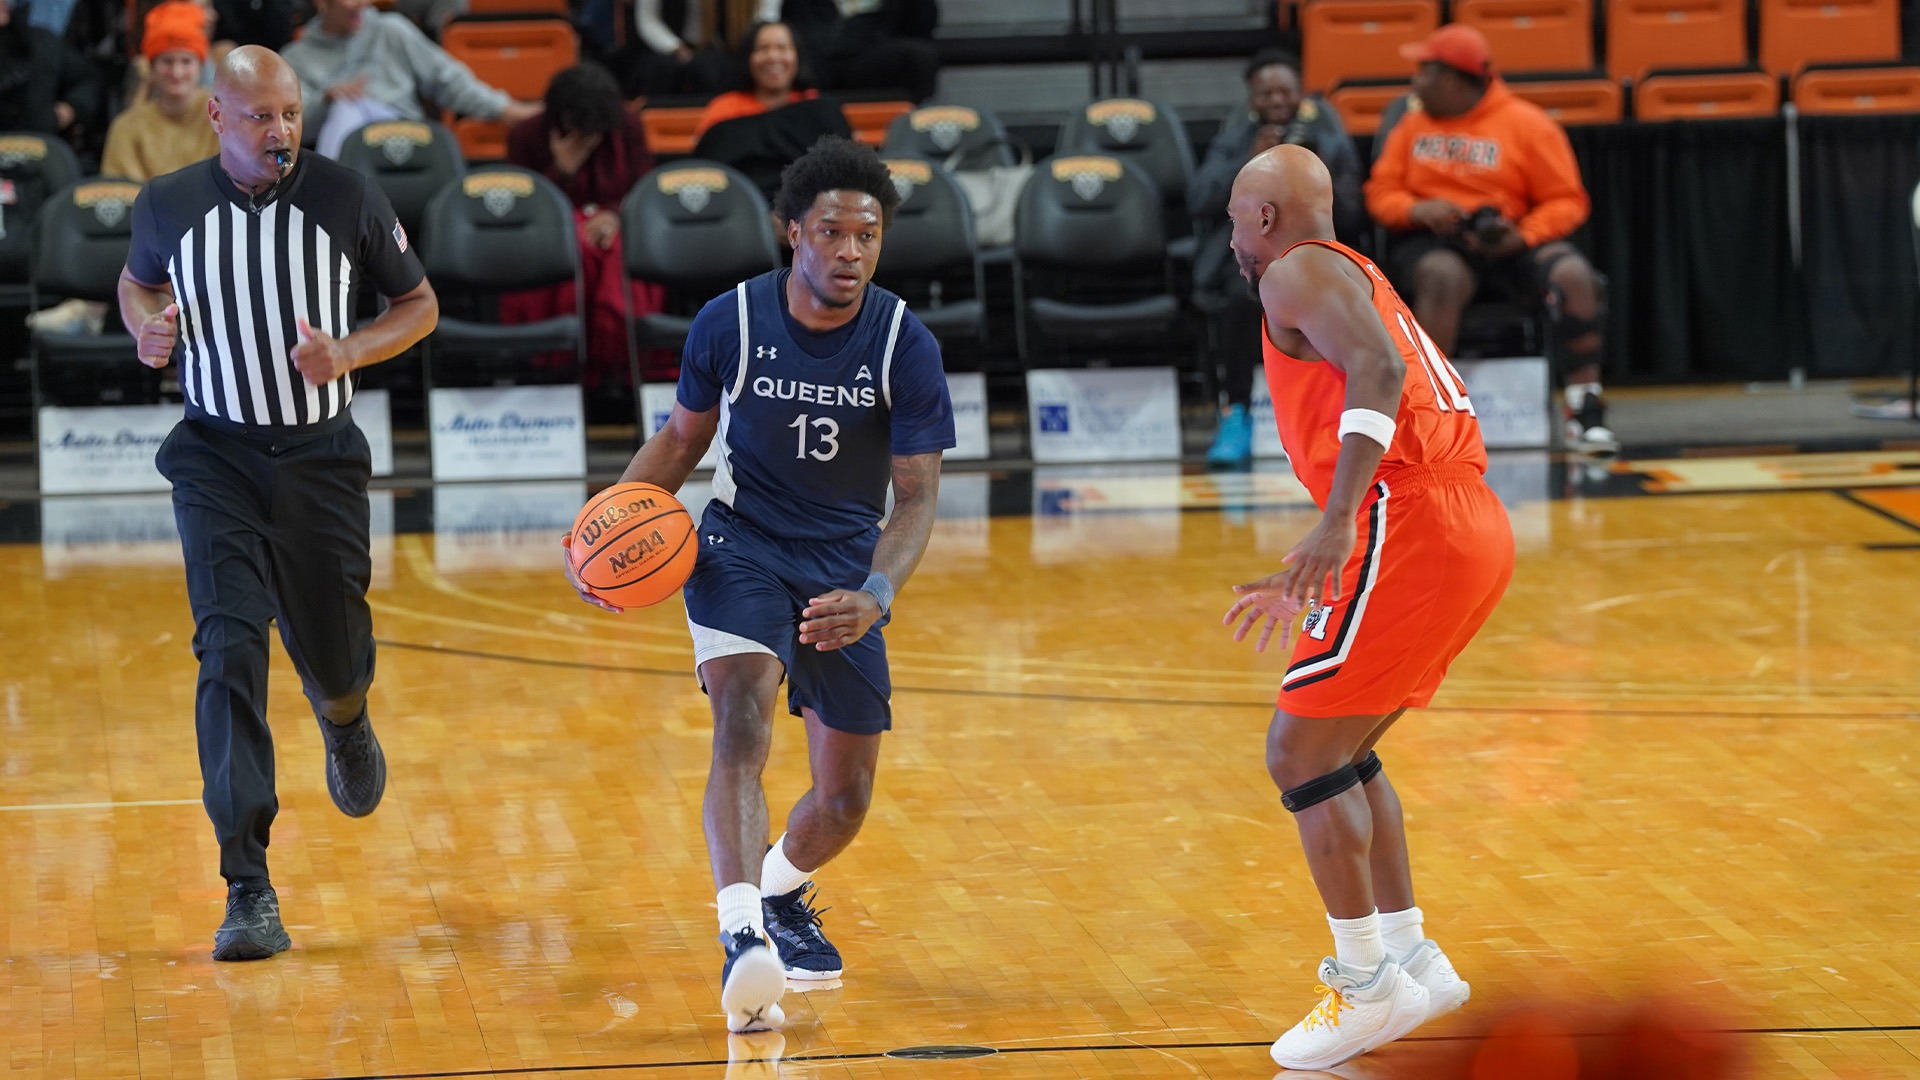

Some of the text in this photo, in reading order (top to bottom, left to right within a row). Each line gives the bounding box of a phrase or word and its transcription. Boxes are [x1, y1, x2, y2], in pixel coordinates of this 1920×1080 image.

[1412, 132, 1502, 171] MERCER
[752, 375, 876, 408] QUEENS
[788, 413, 840, 462] 13
[580, 497, 660, 547] Wilson
[607, 527, 667, 575] NCAA
